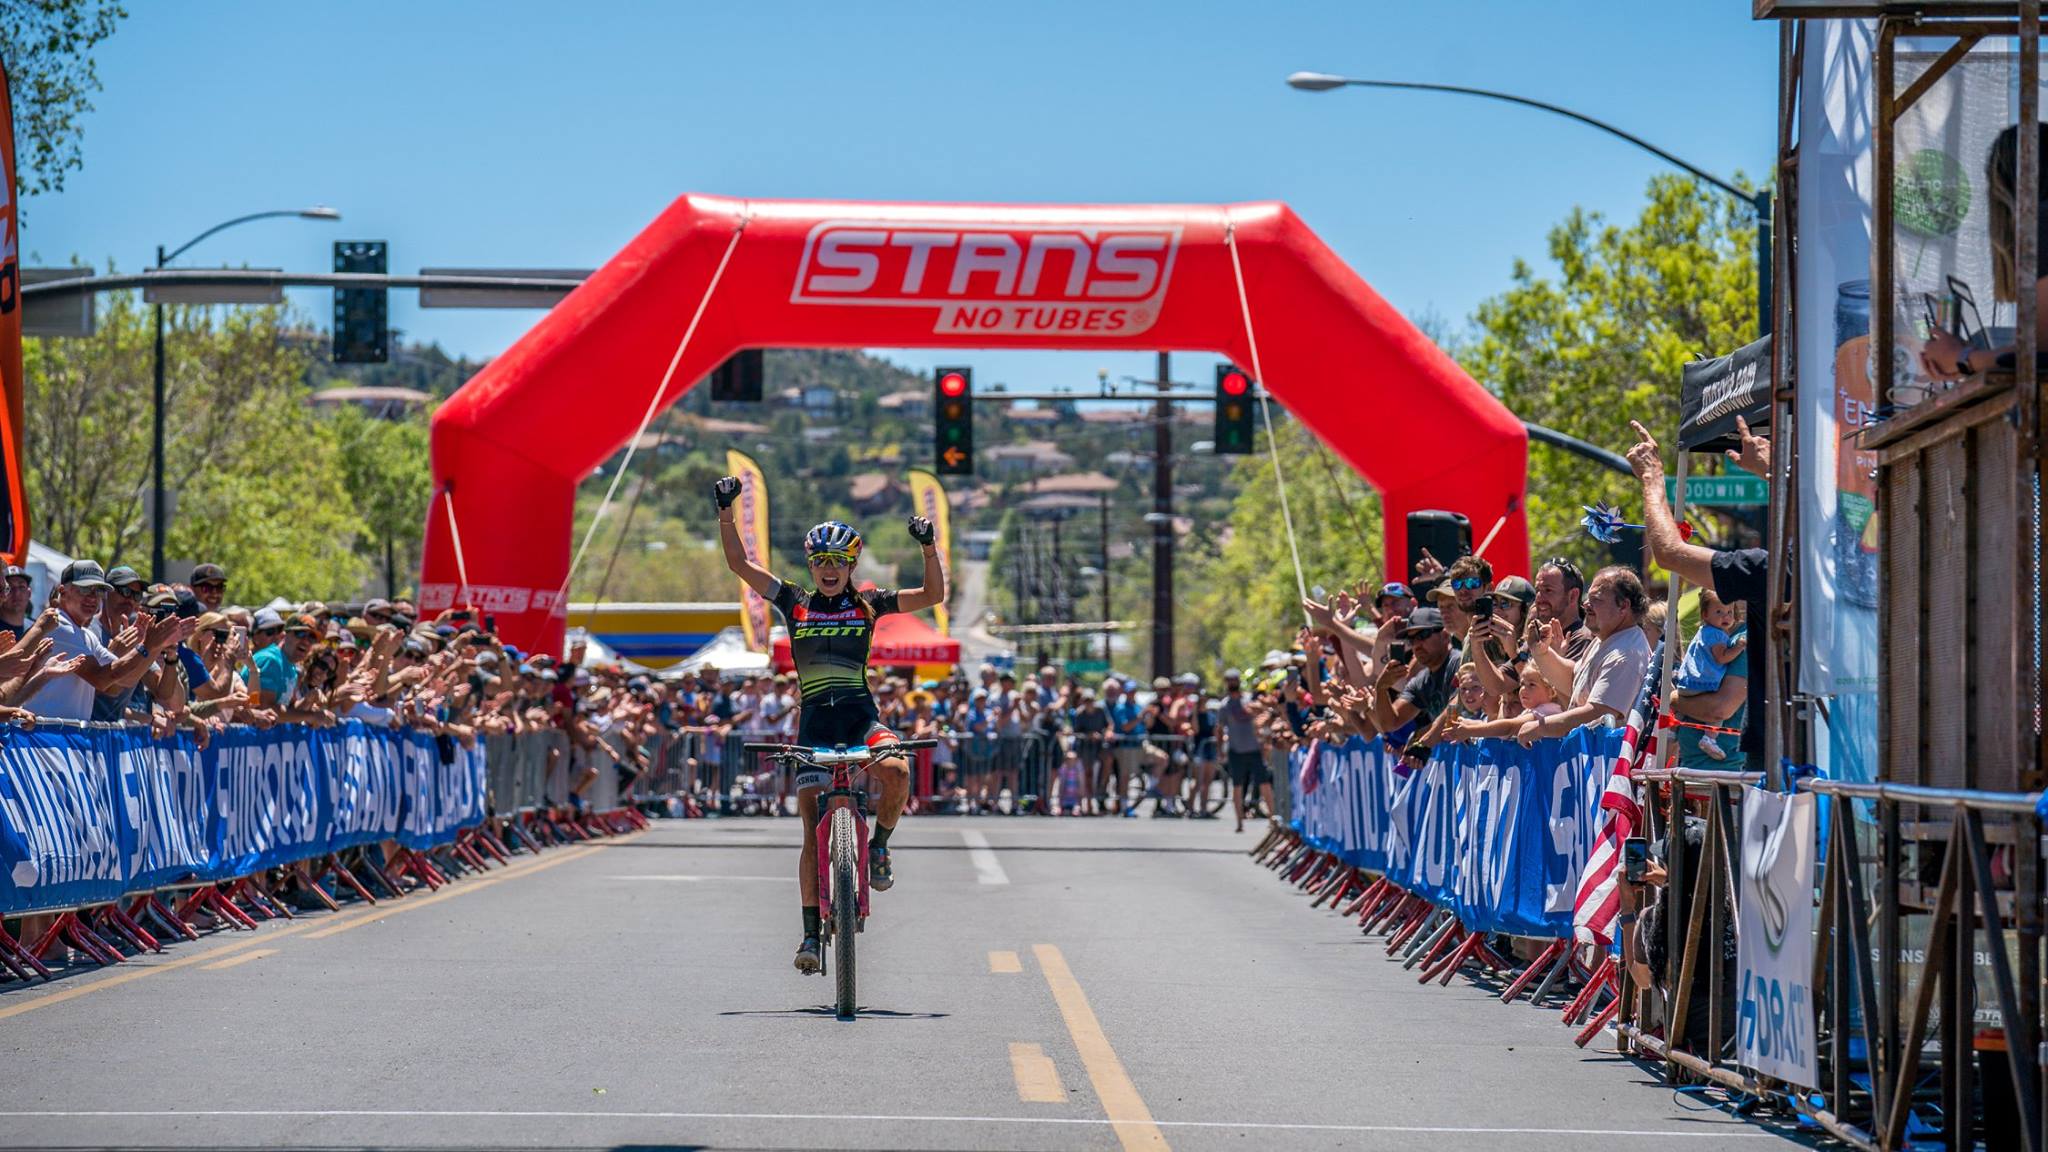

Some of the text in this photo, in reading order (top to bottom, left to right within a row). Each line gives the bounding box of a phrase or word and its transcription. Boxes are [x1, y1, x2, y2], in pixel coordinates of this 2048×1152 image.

[952, 306, 1127, 331] NO TUBES
[793, 626, 867, 640] SCOTT
[1870, 947, 1925, 964] SNS
